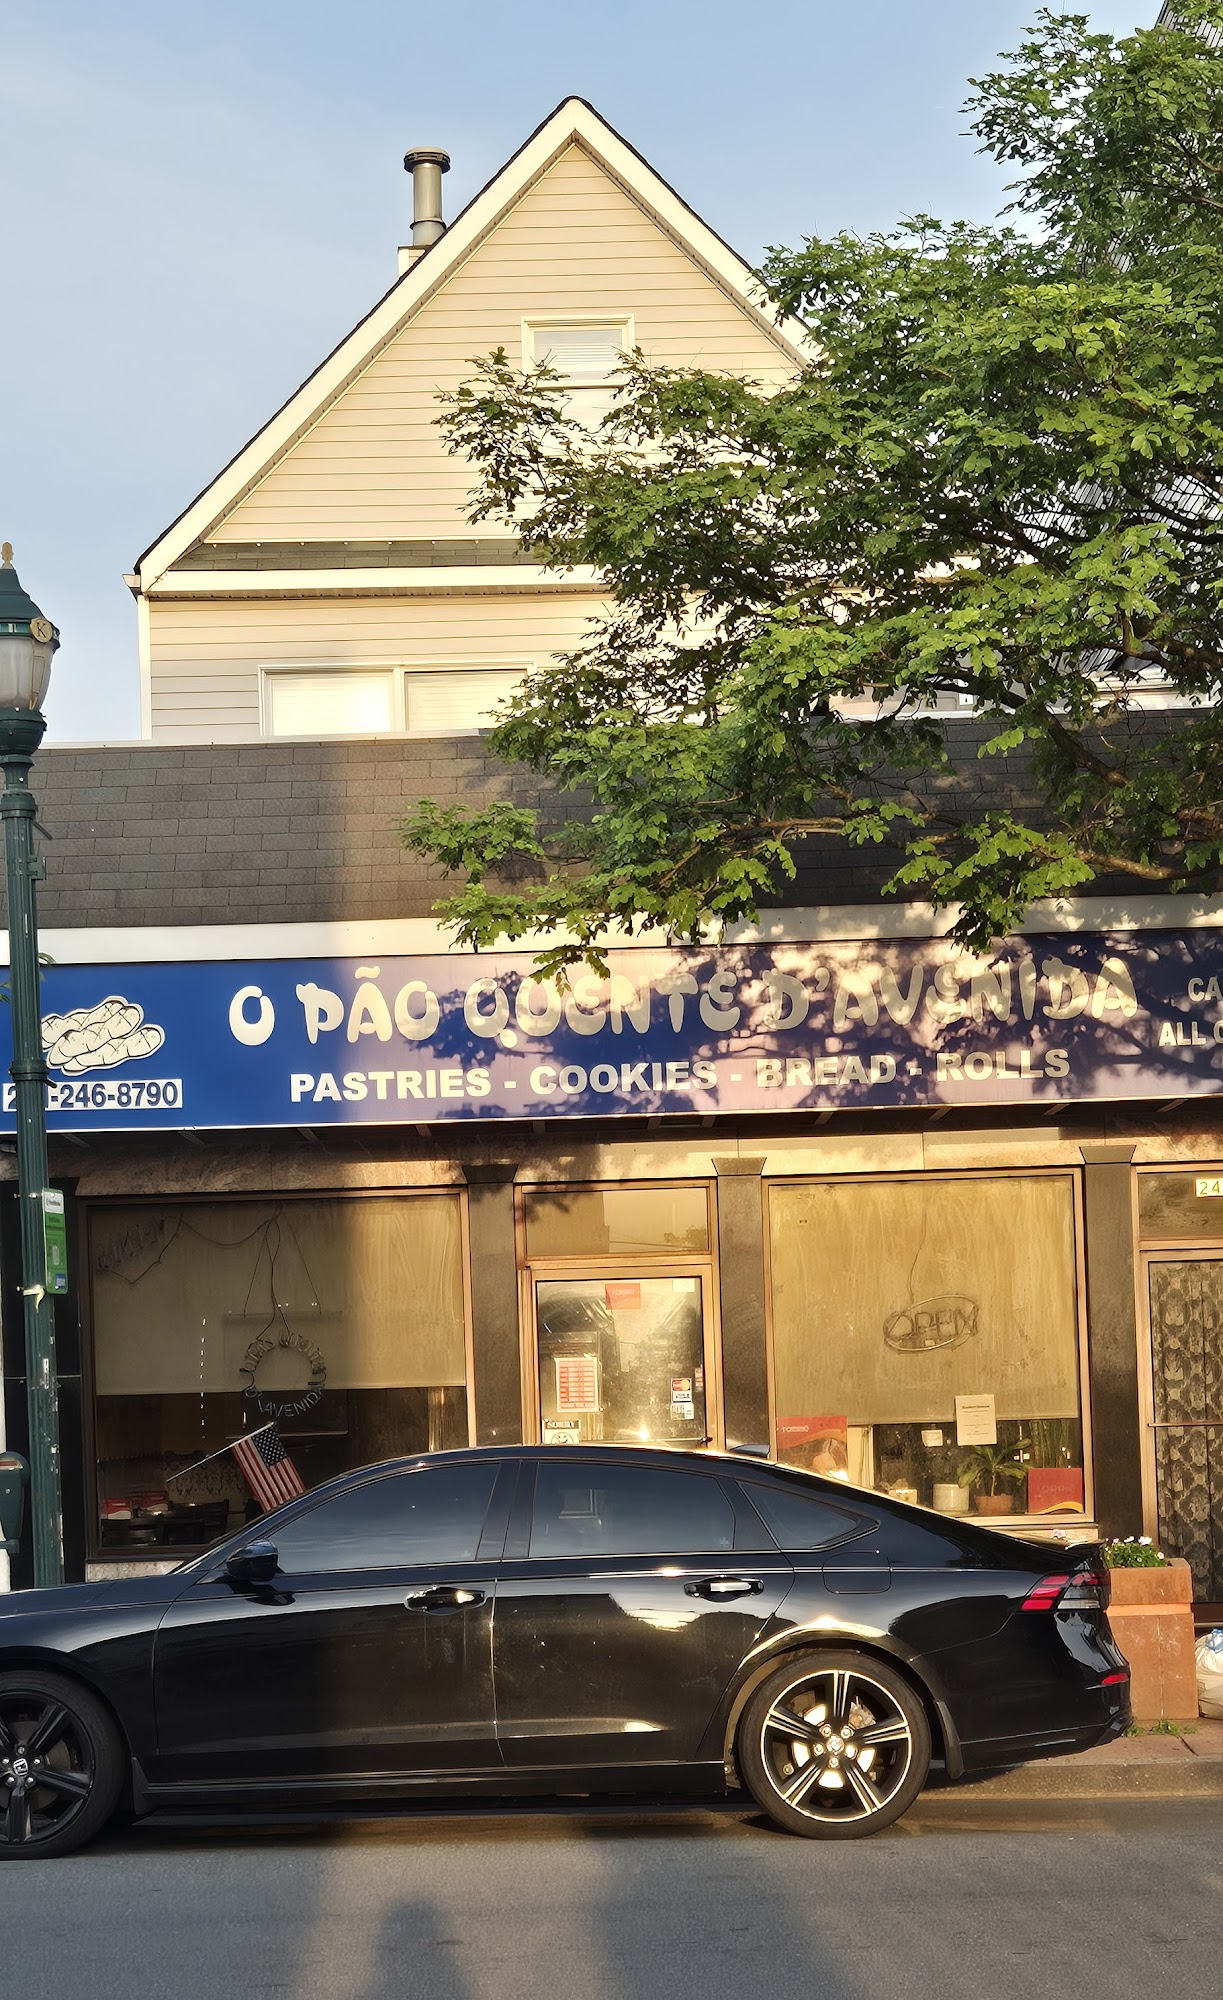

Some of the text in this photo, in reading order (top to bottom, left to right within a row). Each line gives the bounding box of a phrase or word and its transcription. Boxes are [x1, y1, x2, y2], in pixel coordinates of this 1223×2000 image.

[229, 957, 1138, 1049] O PÃO QUENTE D'AVENIDA
[1159, 1021, 1207, 1046] ALL
[290, 1068, 491, 1102] PASTRIES
[530, 1061, 718, 1095] COOKIES
[756, 1054, 897, 1088] BREAD
[936, 1049, 1071, 1083] ROLLS
[7, 1081, 178, 1110] 2-246-8790
[883, 1304, 979, 1342] OPEN
